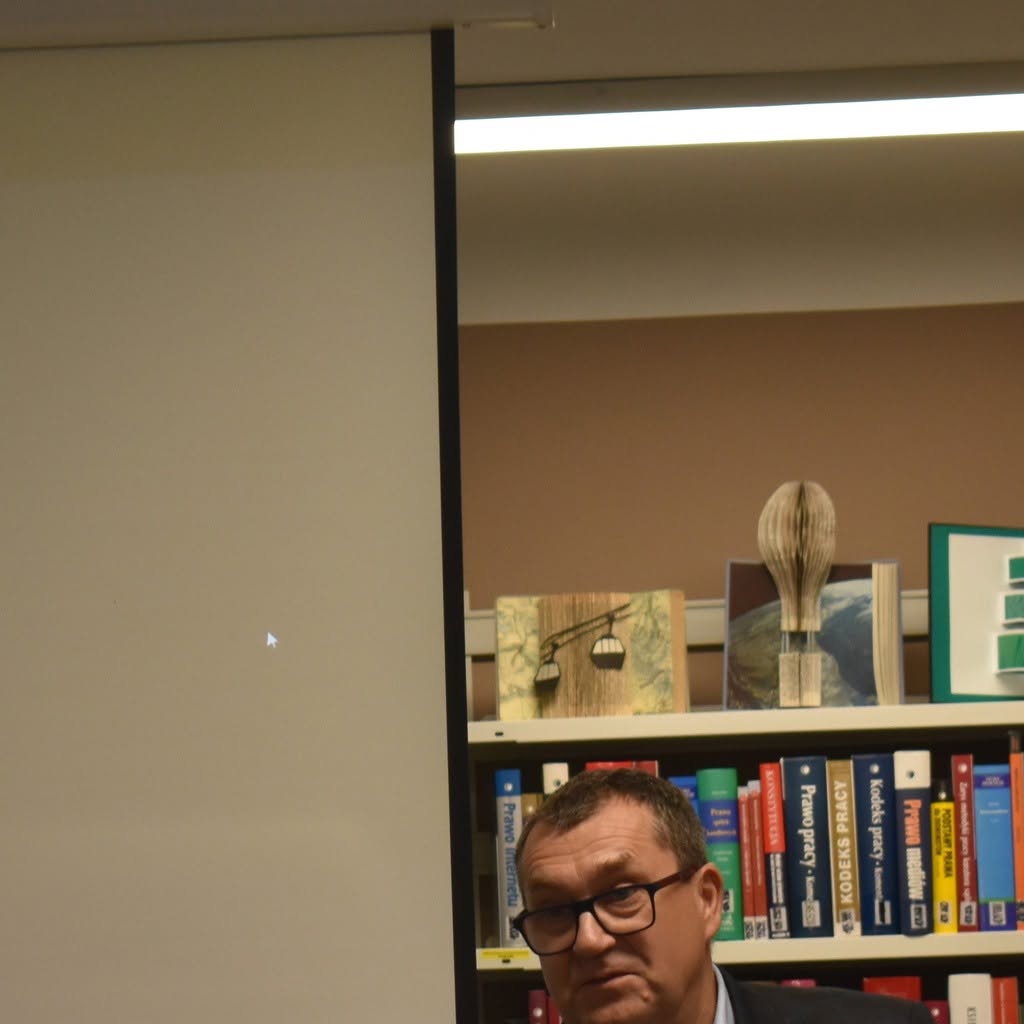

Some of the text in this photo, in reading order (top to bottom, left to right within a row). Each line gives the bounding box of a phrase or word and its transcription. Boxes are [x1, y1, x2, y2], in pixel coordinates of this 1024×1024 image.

[503, 803, 518, 844] Prawo
[801, 784, 817, 828] Prawo
[869, 778, 884, 825] Kodeks
[798, 828, 817, 868] pracy
[834, 780, 853, 904] KODEKS PRACY
[868, 826, 885, 861] pracy
[903, 798, 927, 901] Prawo mediów
